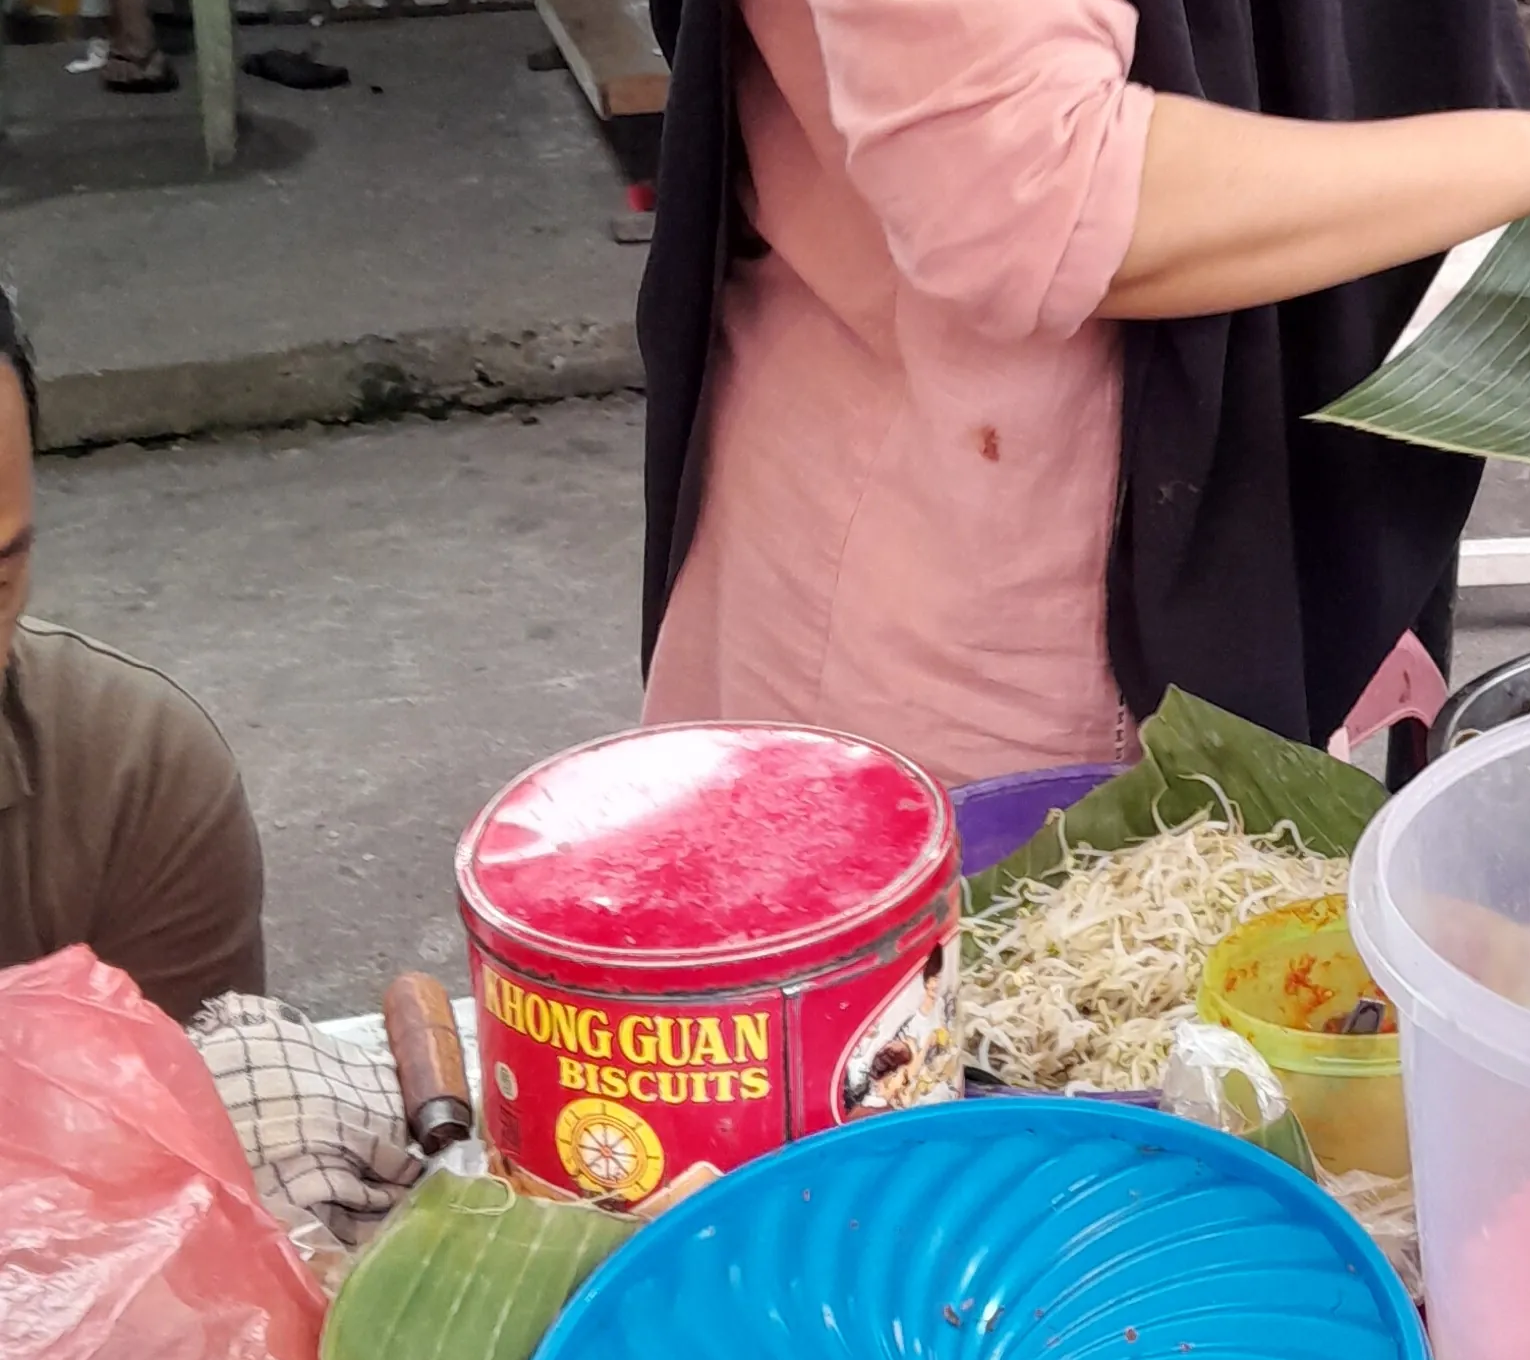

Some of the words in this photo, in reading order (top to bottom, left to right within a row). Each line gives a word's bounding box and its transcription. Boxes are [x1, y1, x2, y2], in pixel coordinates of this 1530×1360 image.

[481, 963, 613, 1061] KHONG
[618, 1012, 771, 1067] GUAN
[556, 1055, 772, 1104] BISCUITS
